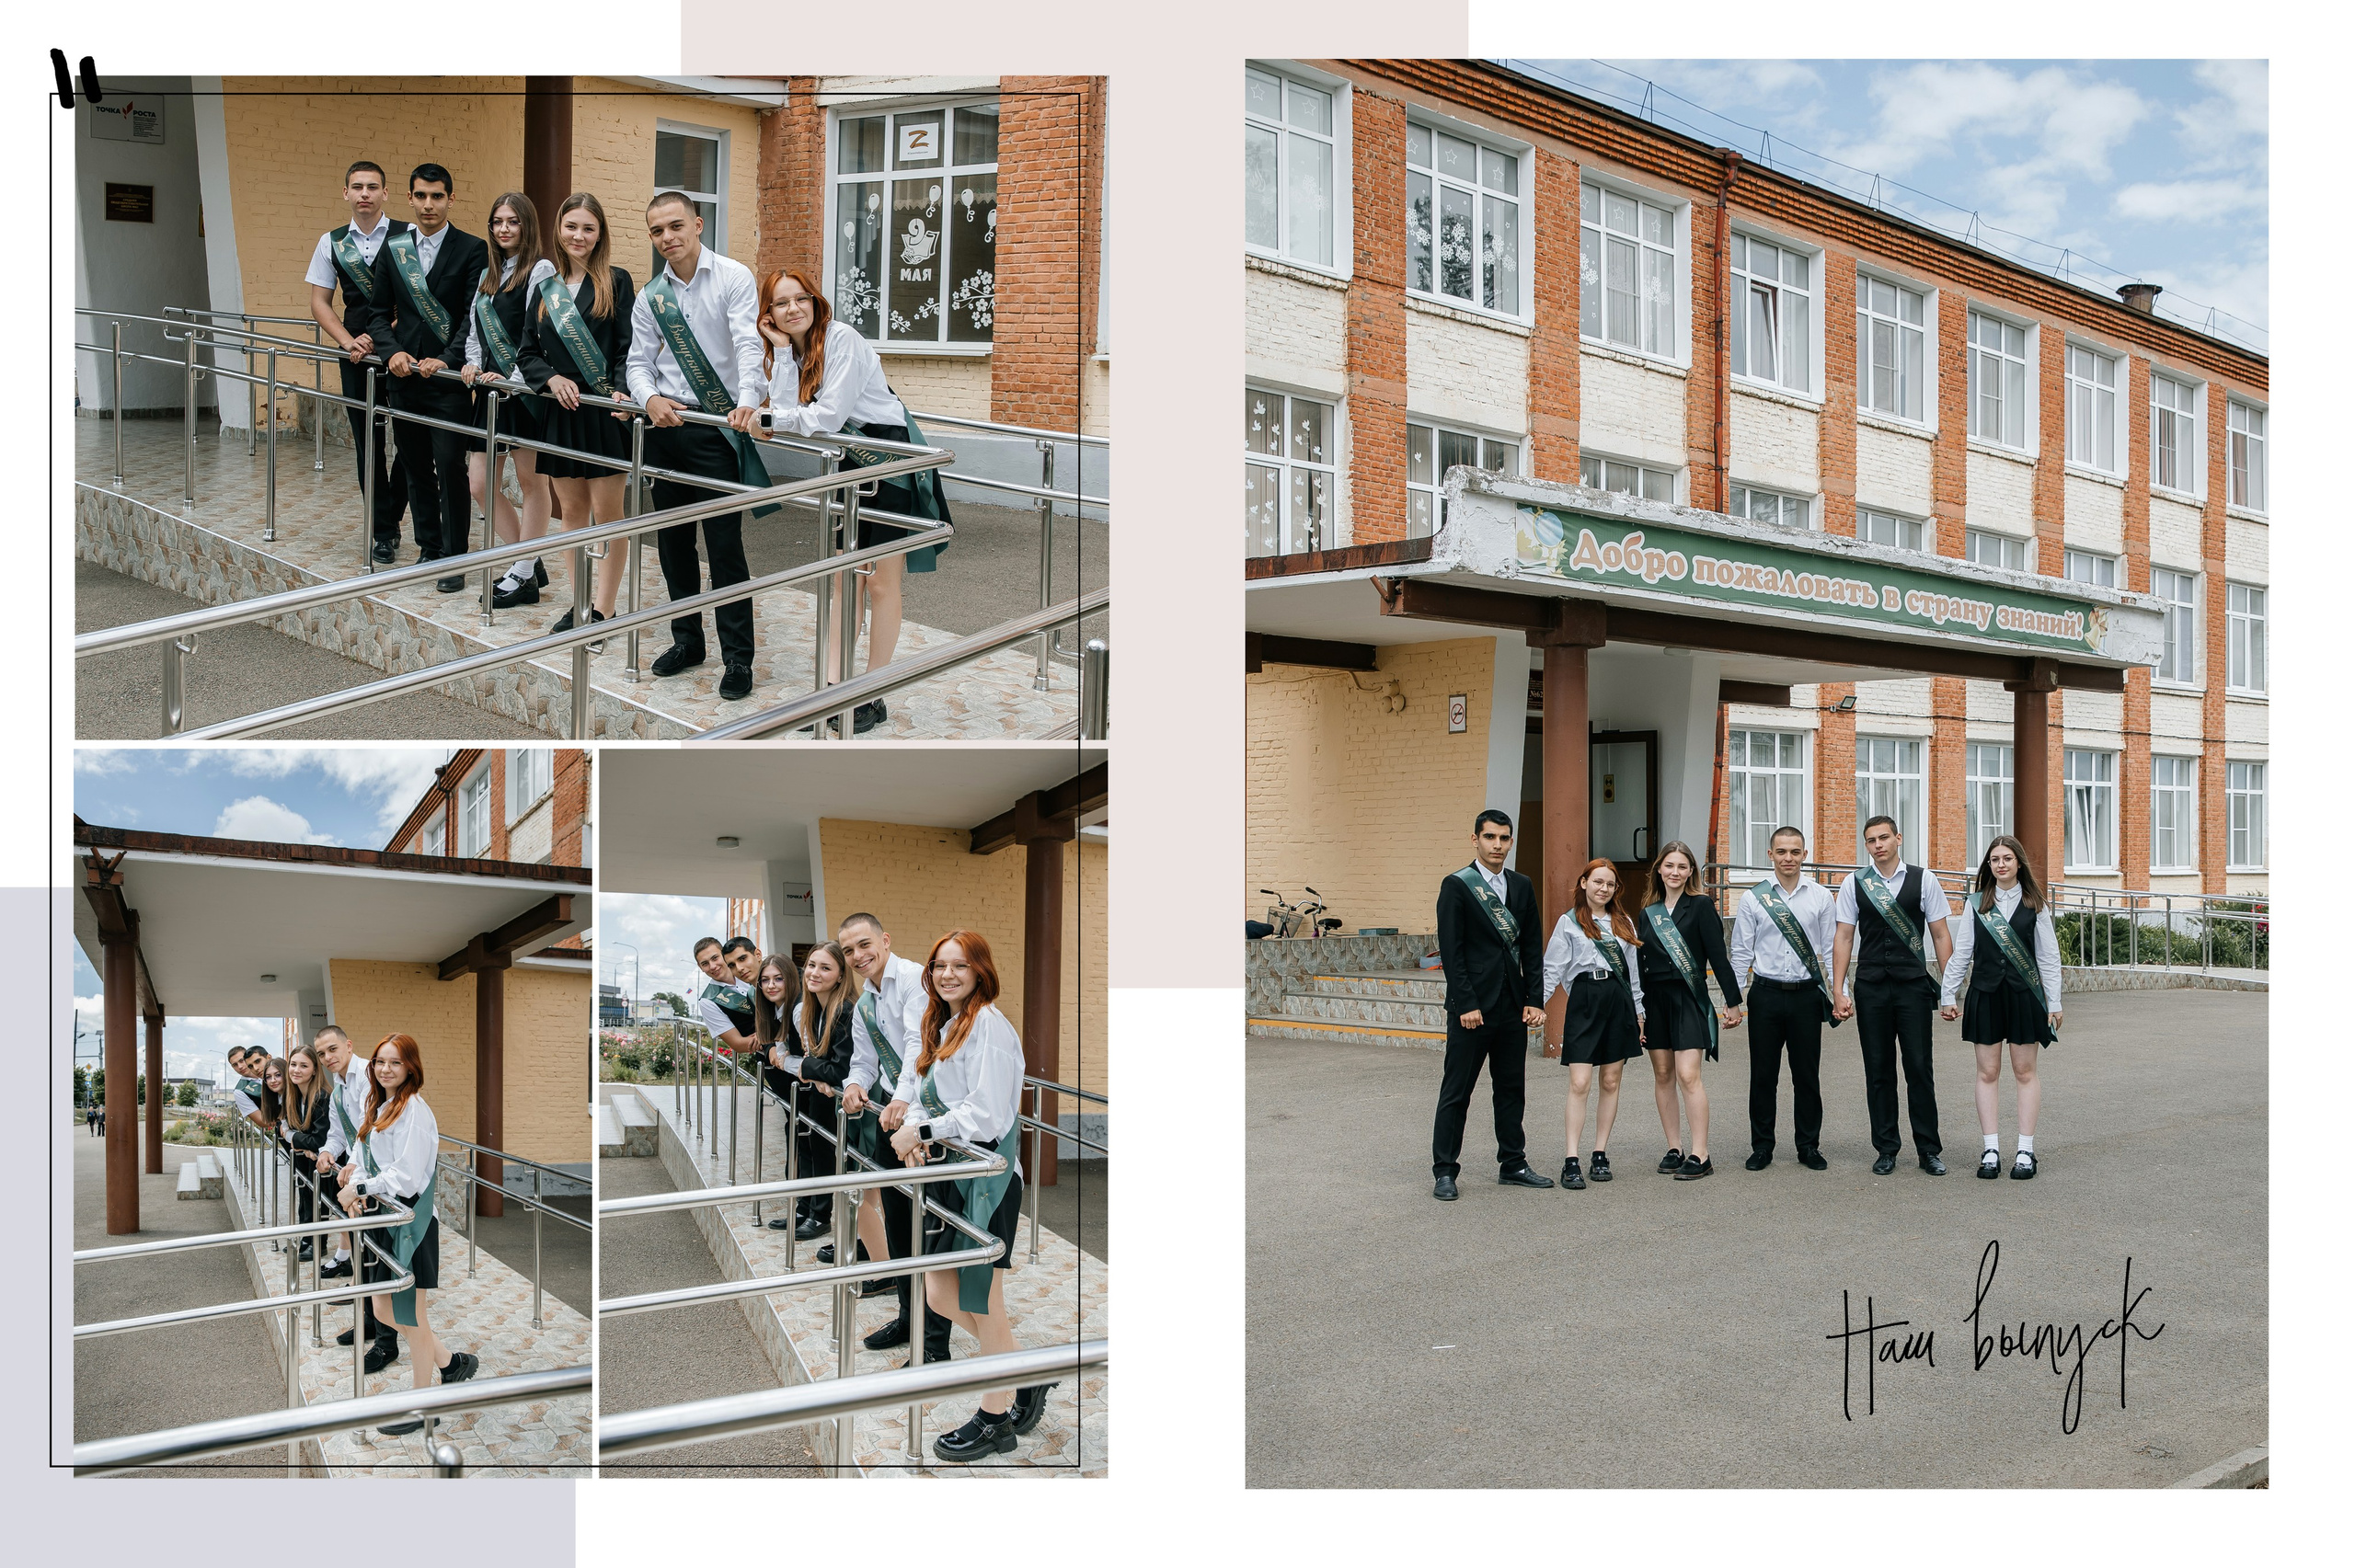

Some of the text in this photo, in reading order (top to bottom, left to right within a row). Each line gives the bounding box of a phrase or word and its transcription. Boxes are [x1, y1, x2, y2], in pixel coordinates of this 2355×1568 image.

[96, 106, 156, 118] ТОЧКА РОСТА
[908, 130, 930, 149] Z
[900, 268, 932, 281] МАЯ
[665, 312, 709, 387] Выпускник
[706, 386, 732, 414] 2024
[1571, 531, 2084, 639] Добро пожаловать в страну знаний!
[1774, 904, 1809, 954] Выпускник
[1875, 888, 1913, 936] Выпускник
[1992, 918, 2030, 970] Выпускница
